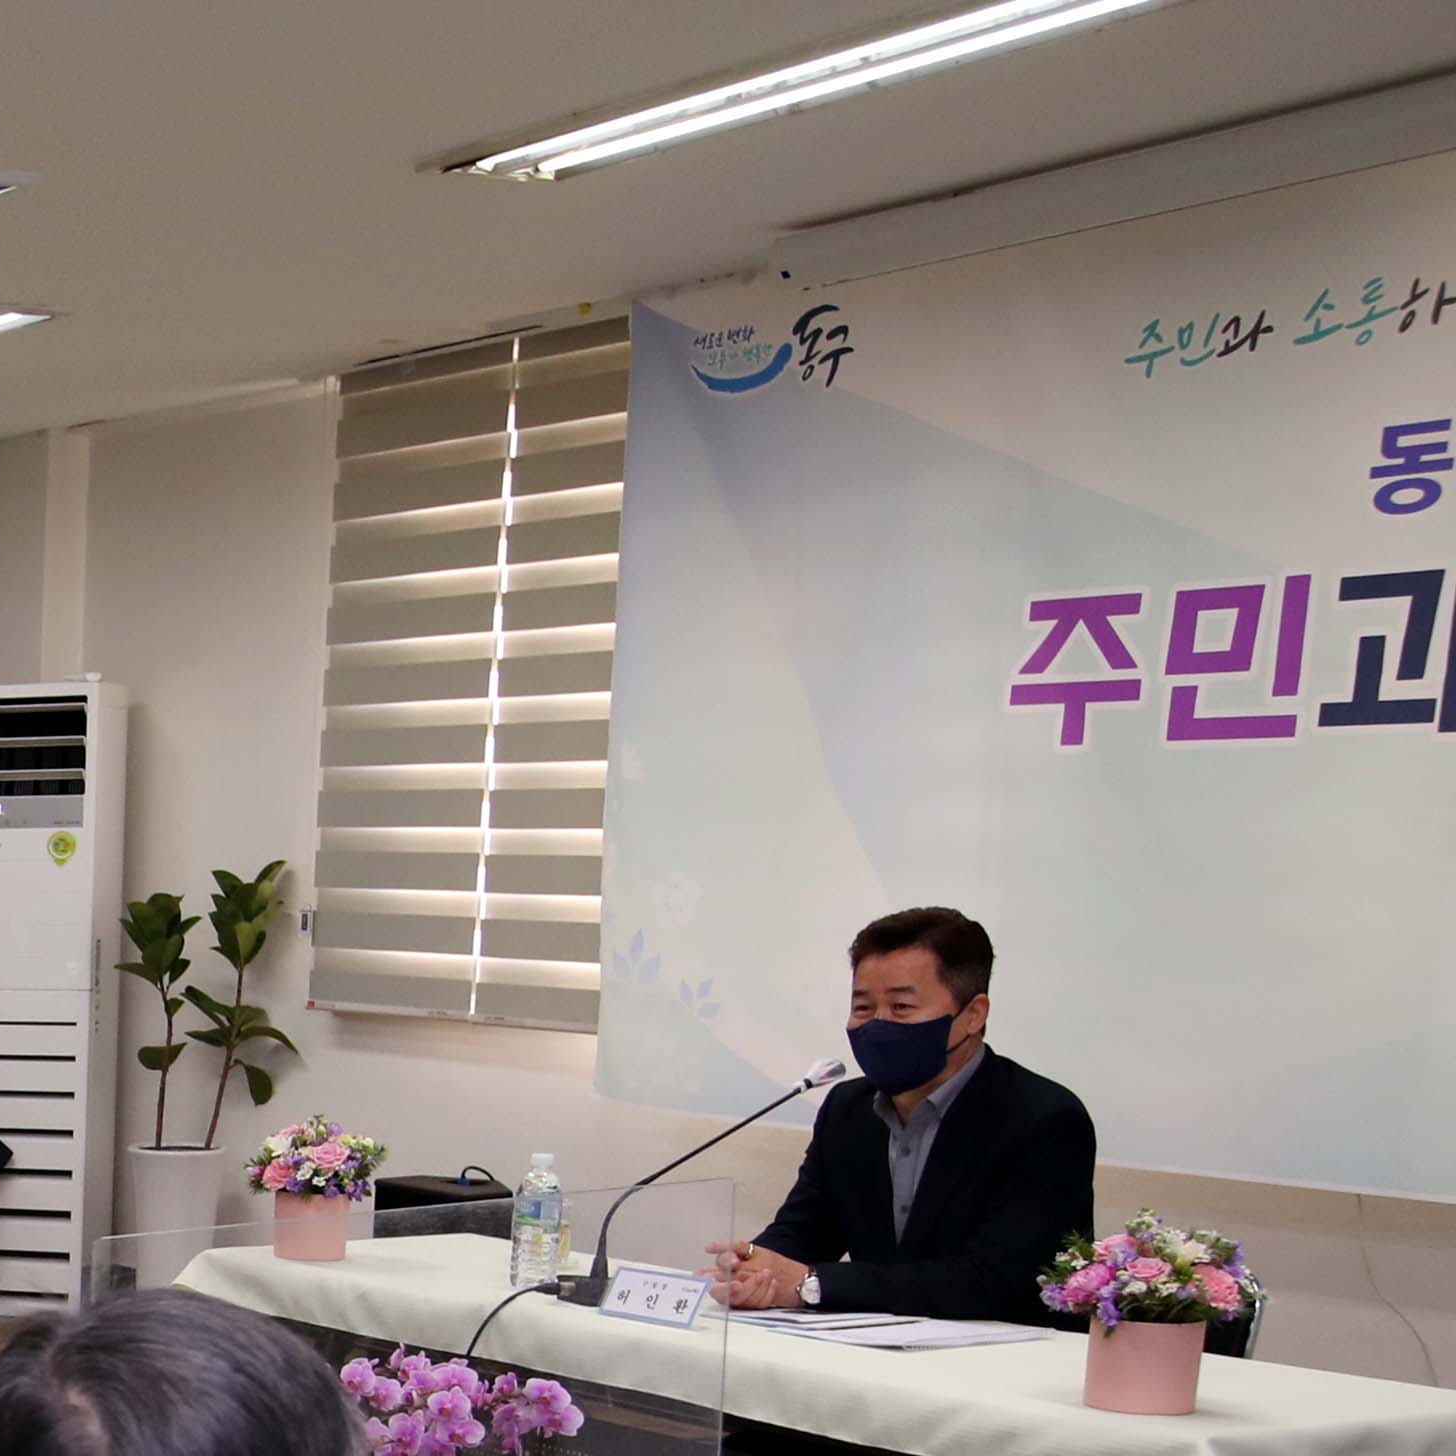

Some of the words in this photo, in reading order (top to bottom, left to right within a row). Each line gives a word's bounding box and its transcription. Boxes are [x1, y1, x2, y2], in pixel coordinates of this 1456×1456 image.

[791, 304, 855, 388] 동구
[1124, 310, 1274, 379] 주민과
[1293, 277, 1456, 347] 소통하
[1368, 418, 1455, 515] 동
[1009, 568, 1456, 747] 주민과
